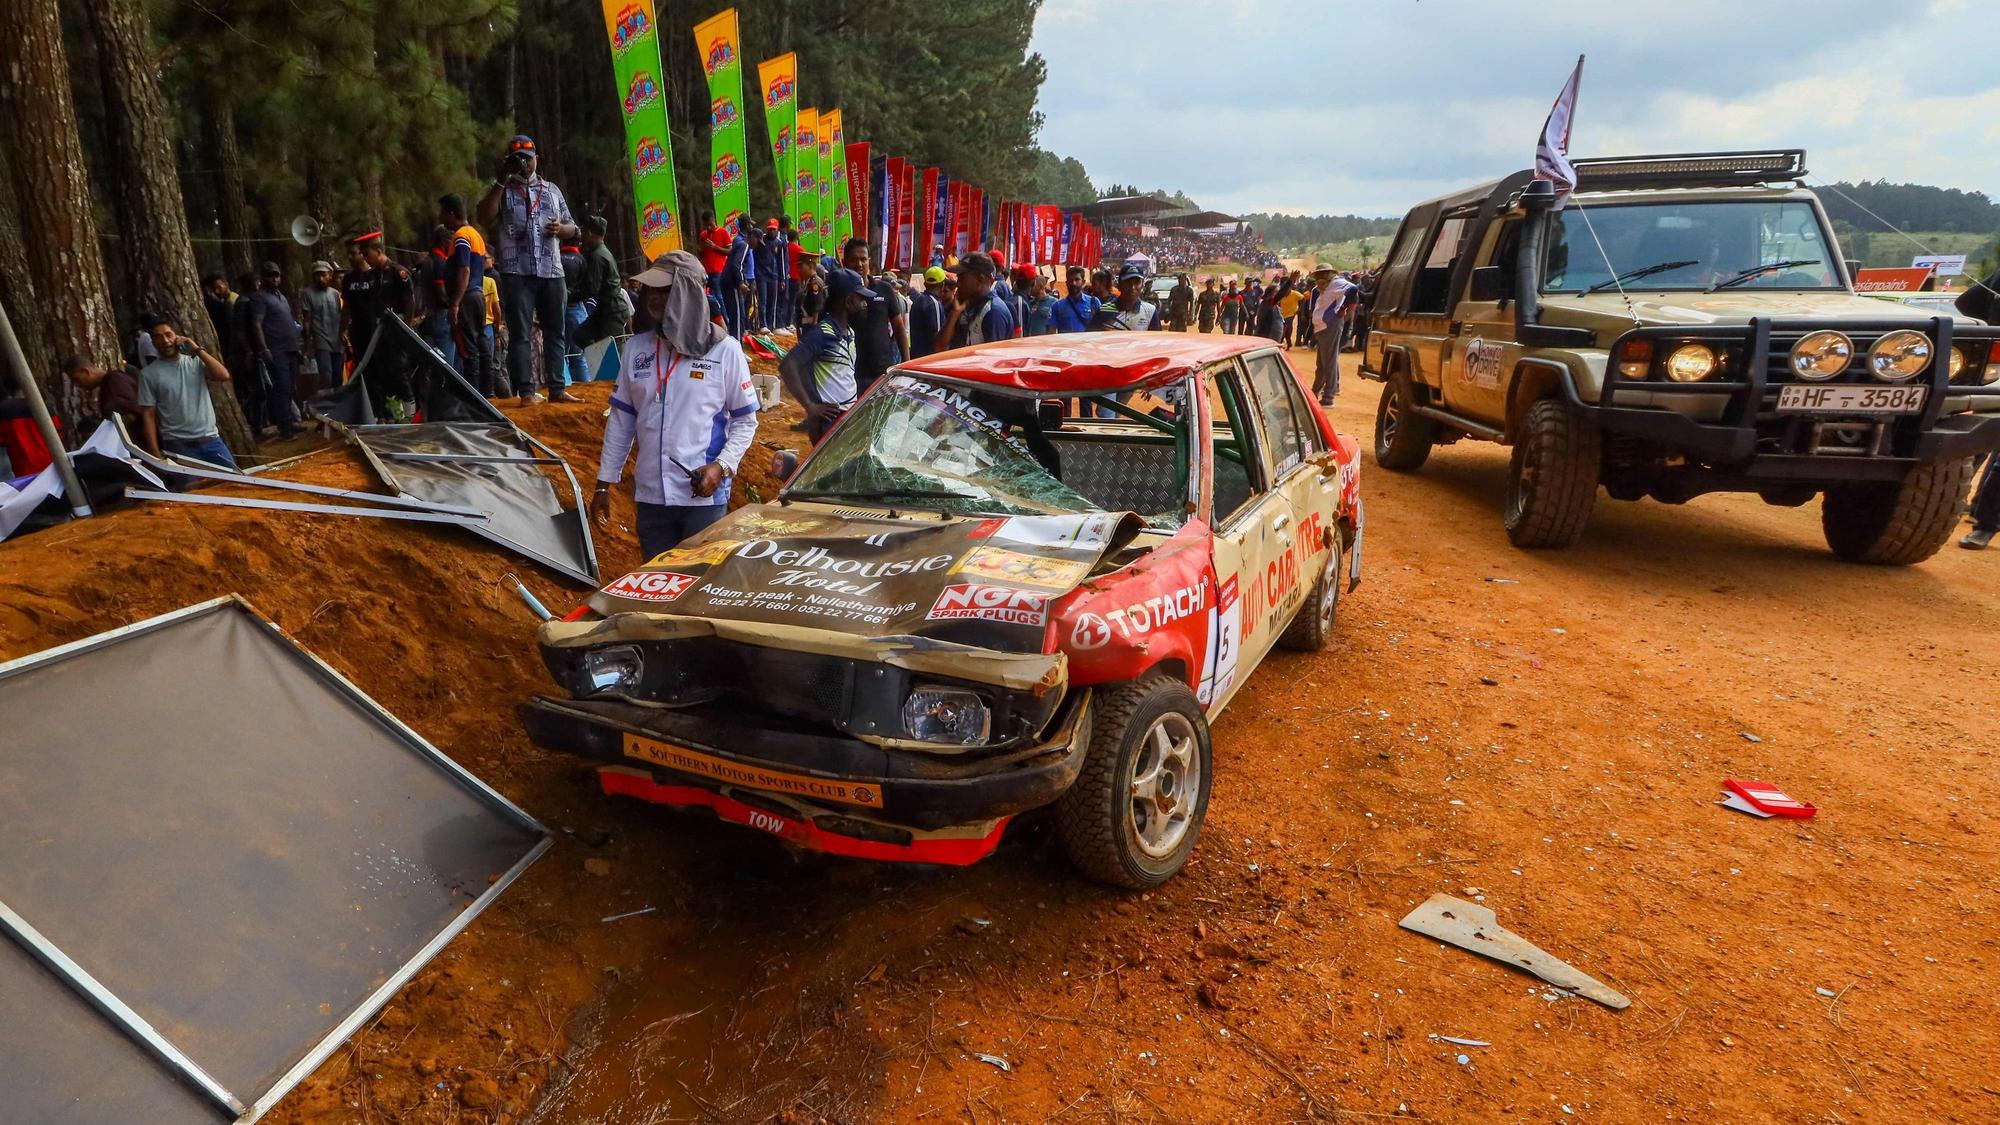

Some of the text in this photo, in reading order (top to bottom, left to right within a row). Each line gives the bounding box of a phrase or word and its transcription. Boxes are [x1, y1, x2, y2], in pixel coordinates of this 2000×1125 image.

[850, 161, 863, 222] asianpaints
[1854, 279, 1909, 292] asianpaints
[1801, 388, 1836, 407] HF
[1859, 389, 1919, 408] 3584
[956, 409, 989, 432] Tuned
[736, 538, 954, 578] Delhousie
[609, 588, 675, 601] SPARK PLUGS
[615, 573, 692, 594] NGK
[767, 569, 883, 598] Hotel
[699, 583, 743, 599] Adam
[754, 591, 795, 603] peak
[805, 593, 917, 617] Nallathanniya
[708, 597, 730, 606] 052
[730, 599, 747, 607] 22
[748, 600, 766, 609] 77
[765, 601, 790, 612] 660
[797, 605, 821, 615] 052
[823, 608, 843, 617] 22
[844, 610, 862, 620] 77
[863, 614, 890, 626] 661
[934, 584, 1043, 613] NGK
[1240, 570, 1264, 646] AUTO
[931, 608, 1041, 626] SPARK PLUGS
[1220, 625, 1230, 662] 5
[711, 764, 756, 784] MOTOR
[758, 773, 807, 793] SPORTS
[809, 783, 847, 798] CLUB
[748, 809, 784, 833] TOW
